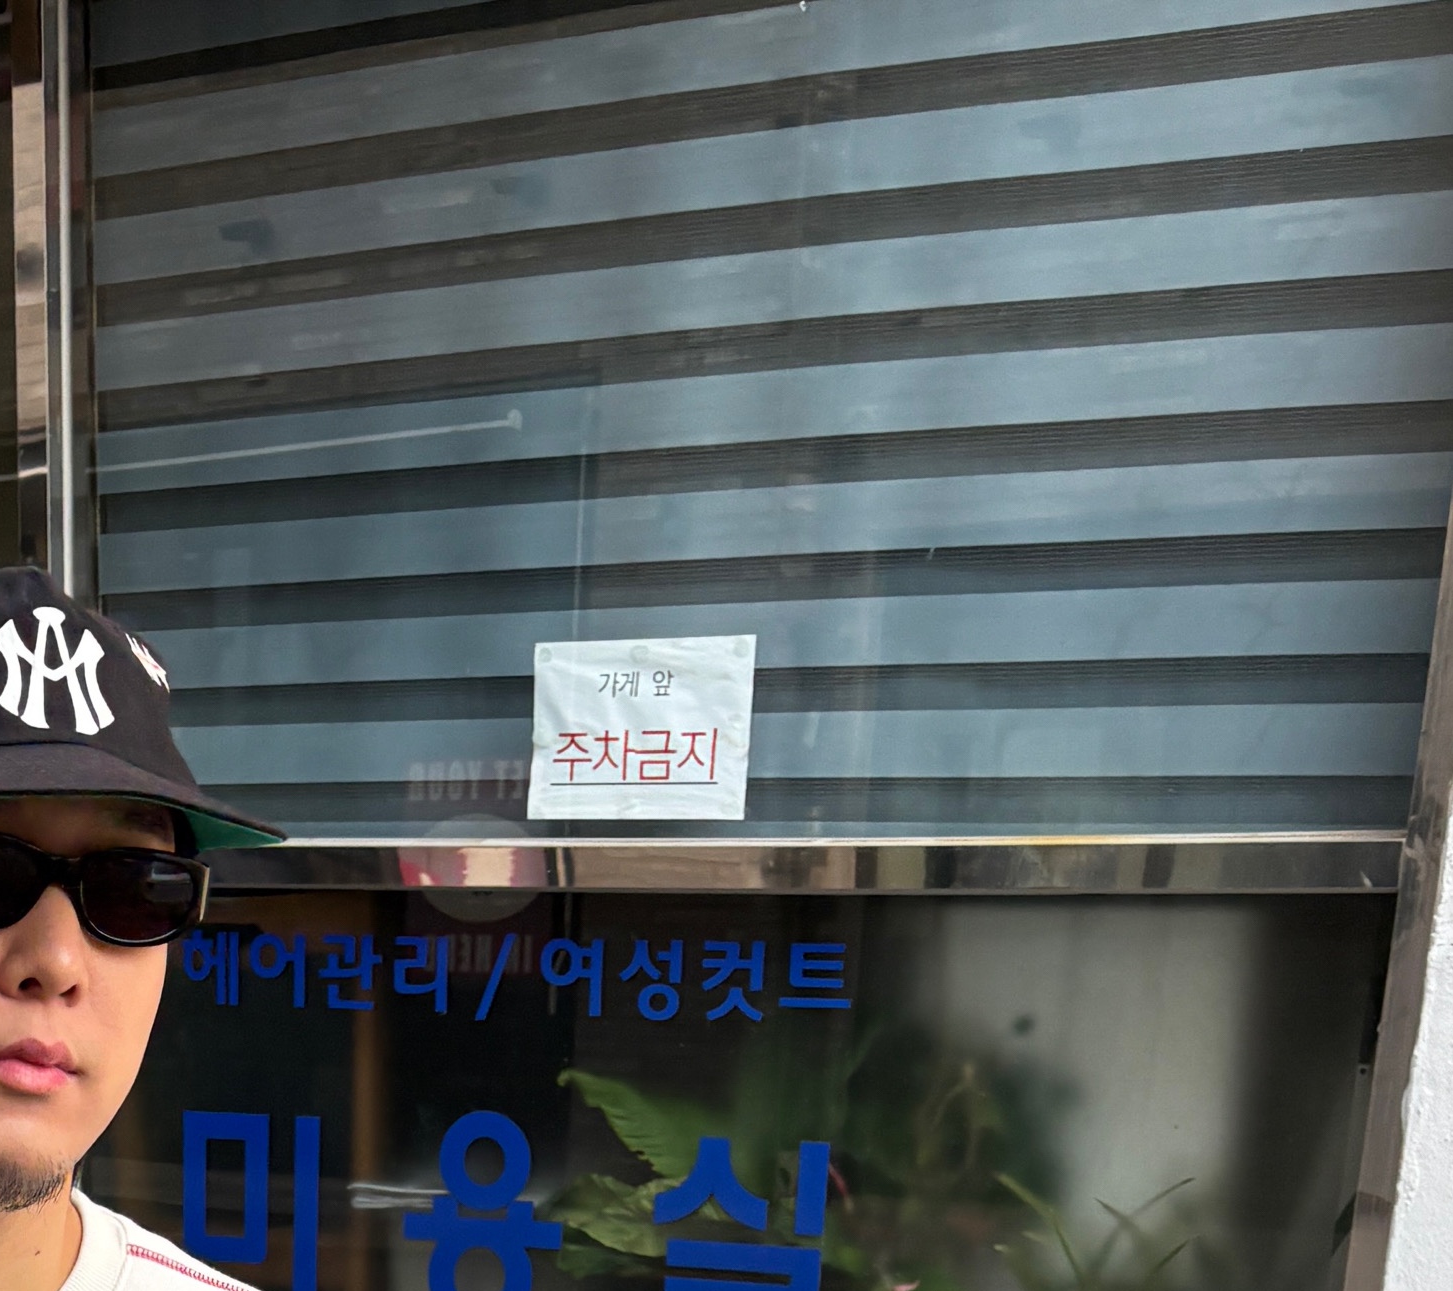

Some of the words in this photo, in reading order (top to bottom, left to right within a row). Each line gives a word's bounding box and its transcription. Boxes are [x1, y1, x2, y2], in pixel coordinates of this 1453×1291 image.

[598, 671, 640, 698] 가게
[652, 670, 675, 697] 앞
[552, 727, 718, 781] 주차금지
